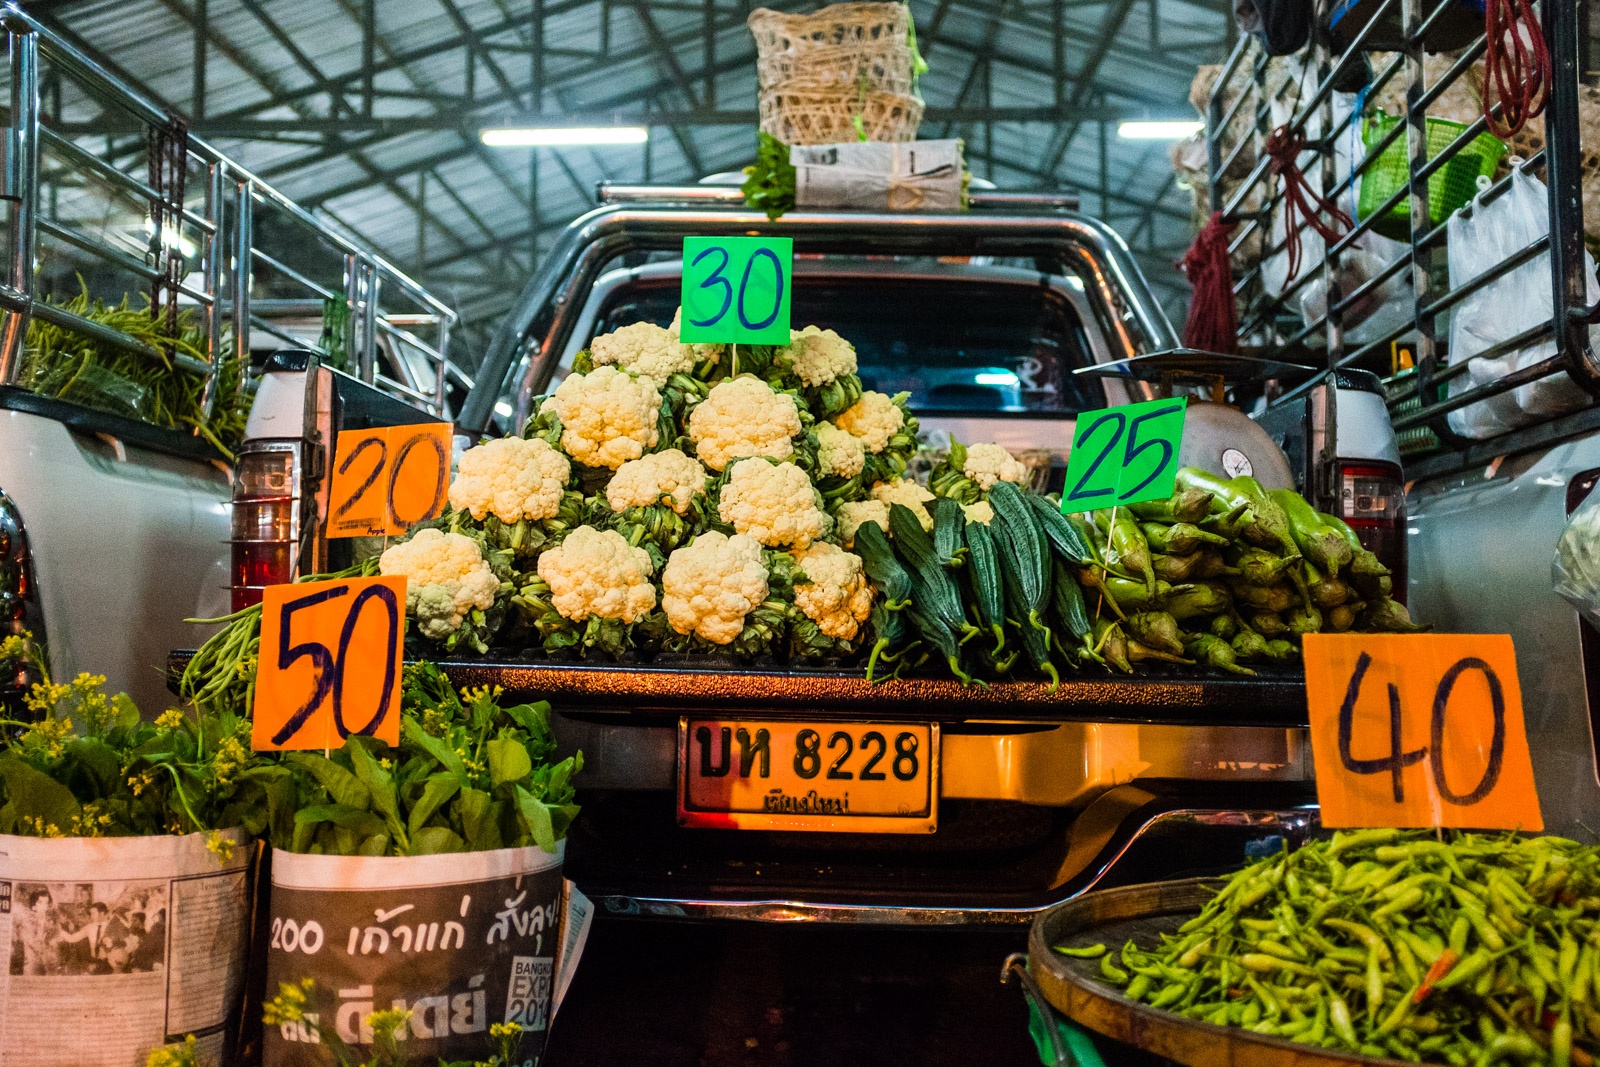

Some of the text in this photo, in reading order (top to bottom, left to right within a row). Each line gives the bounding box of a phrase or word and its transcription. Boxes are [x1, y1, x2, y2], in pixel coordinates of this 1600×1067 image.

[689, 246, 784, 331] 30
[332, 432, 446, 529] 20
[1067, 405, 1182, 501] 25
[271, 584, 398, 745] 50
[793, 729, 919, 781] 8228
[1338, 651, 1505, 806] 40
[271, 917, 324, 955] 200
